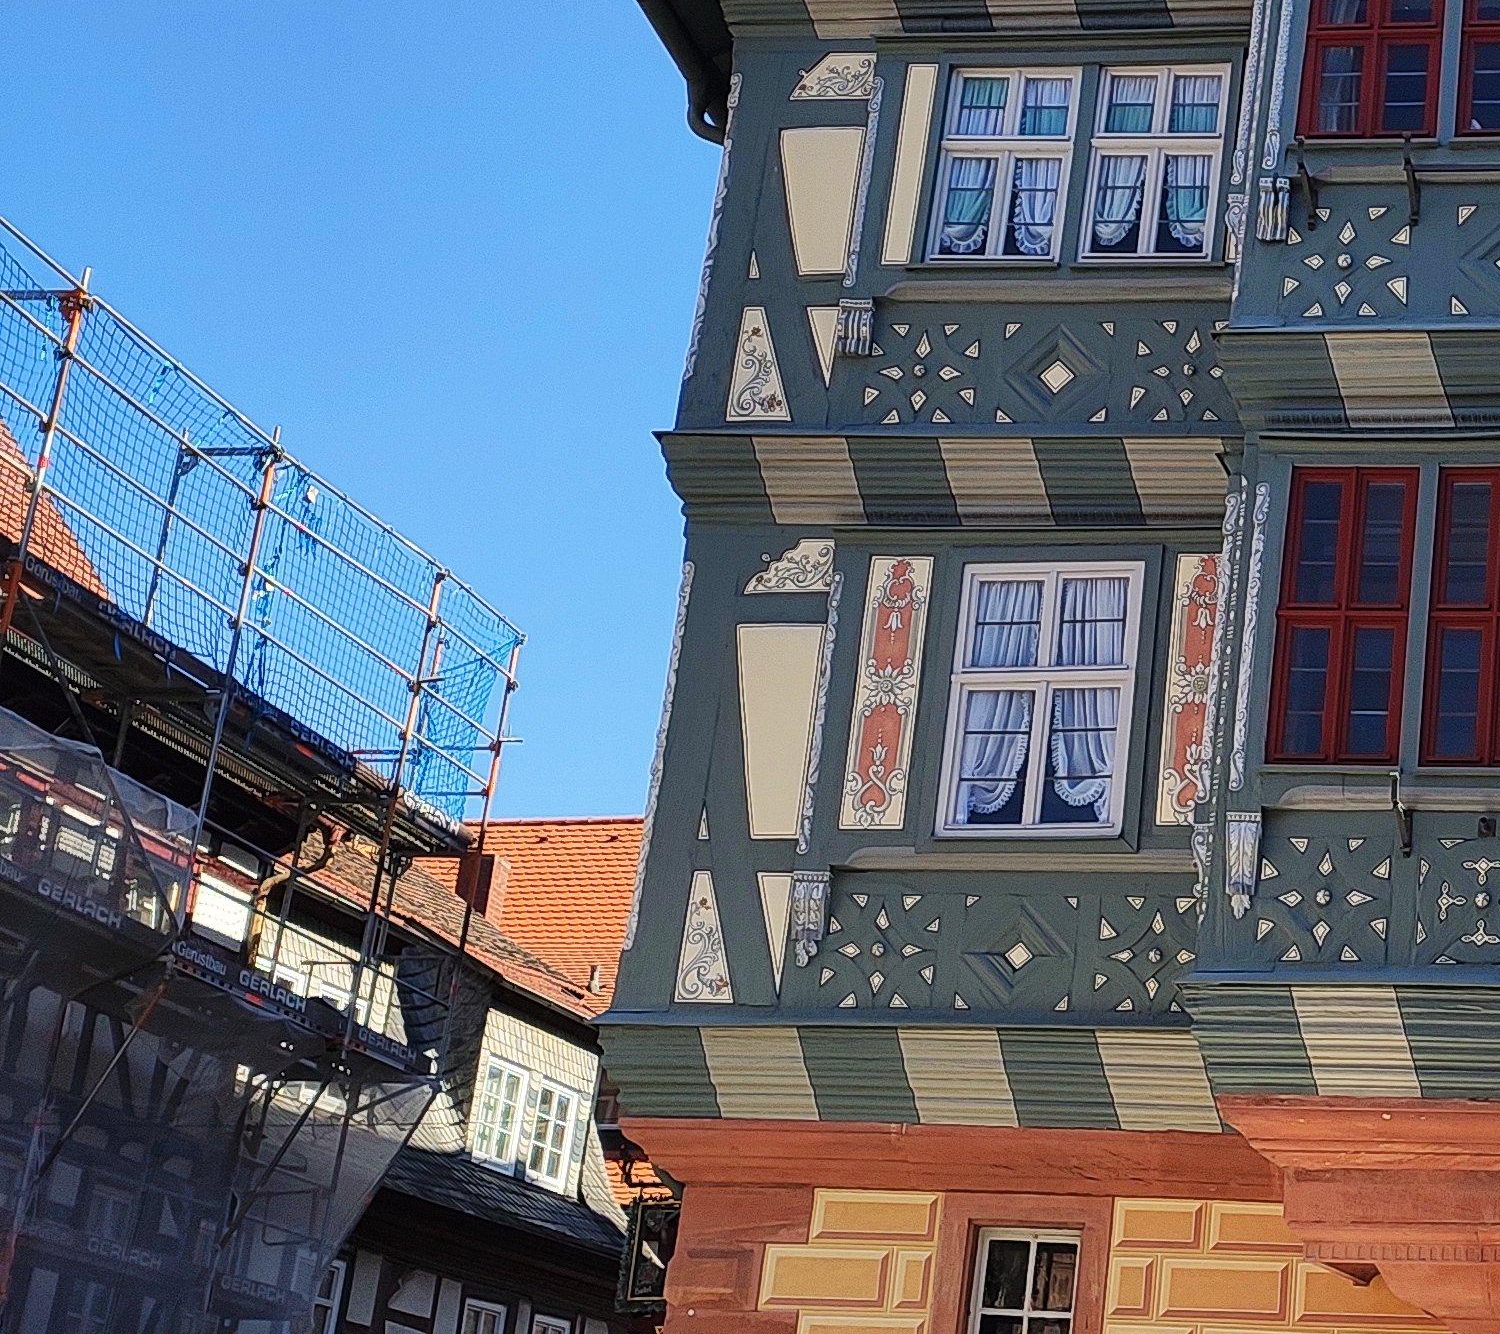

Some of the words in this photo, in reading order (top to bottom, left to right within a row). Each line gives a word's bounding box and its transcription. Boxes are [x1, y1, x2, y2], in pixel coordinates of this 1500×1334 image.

[38, 878, 122, 929] GERLACH
[239, 969, 307, 1013] GERLACH
[358, 1027, 417, 1064] GERLACH
